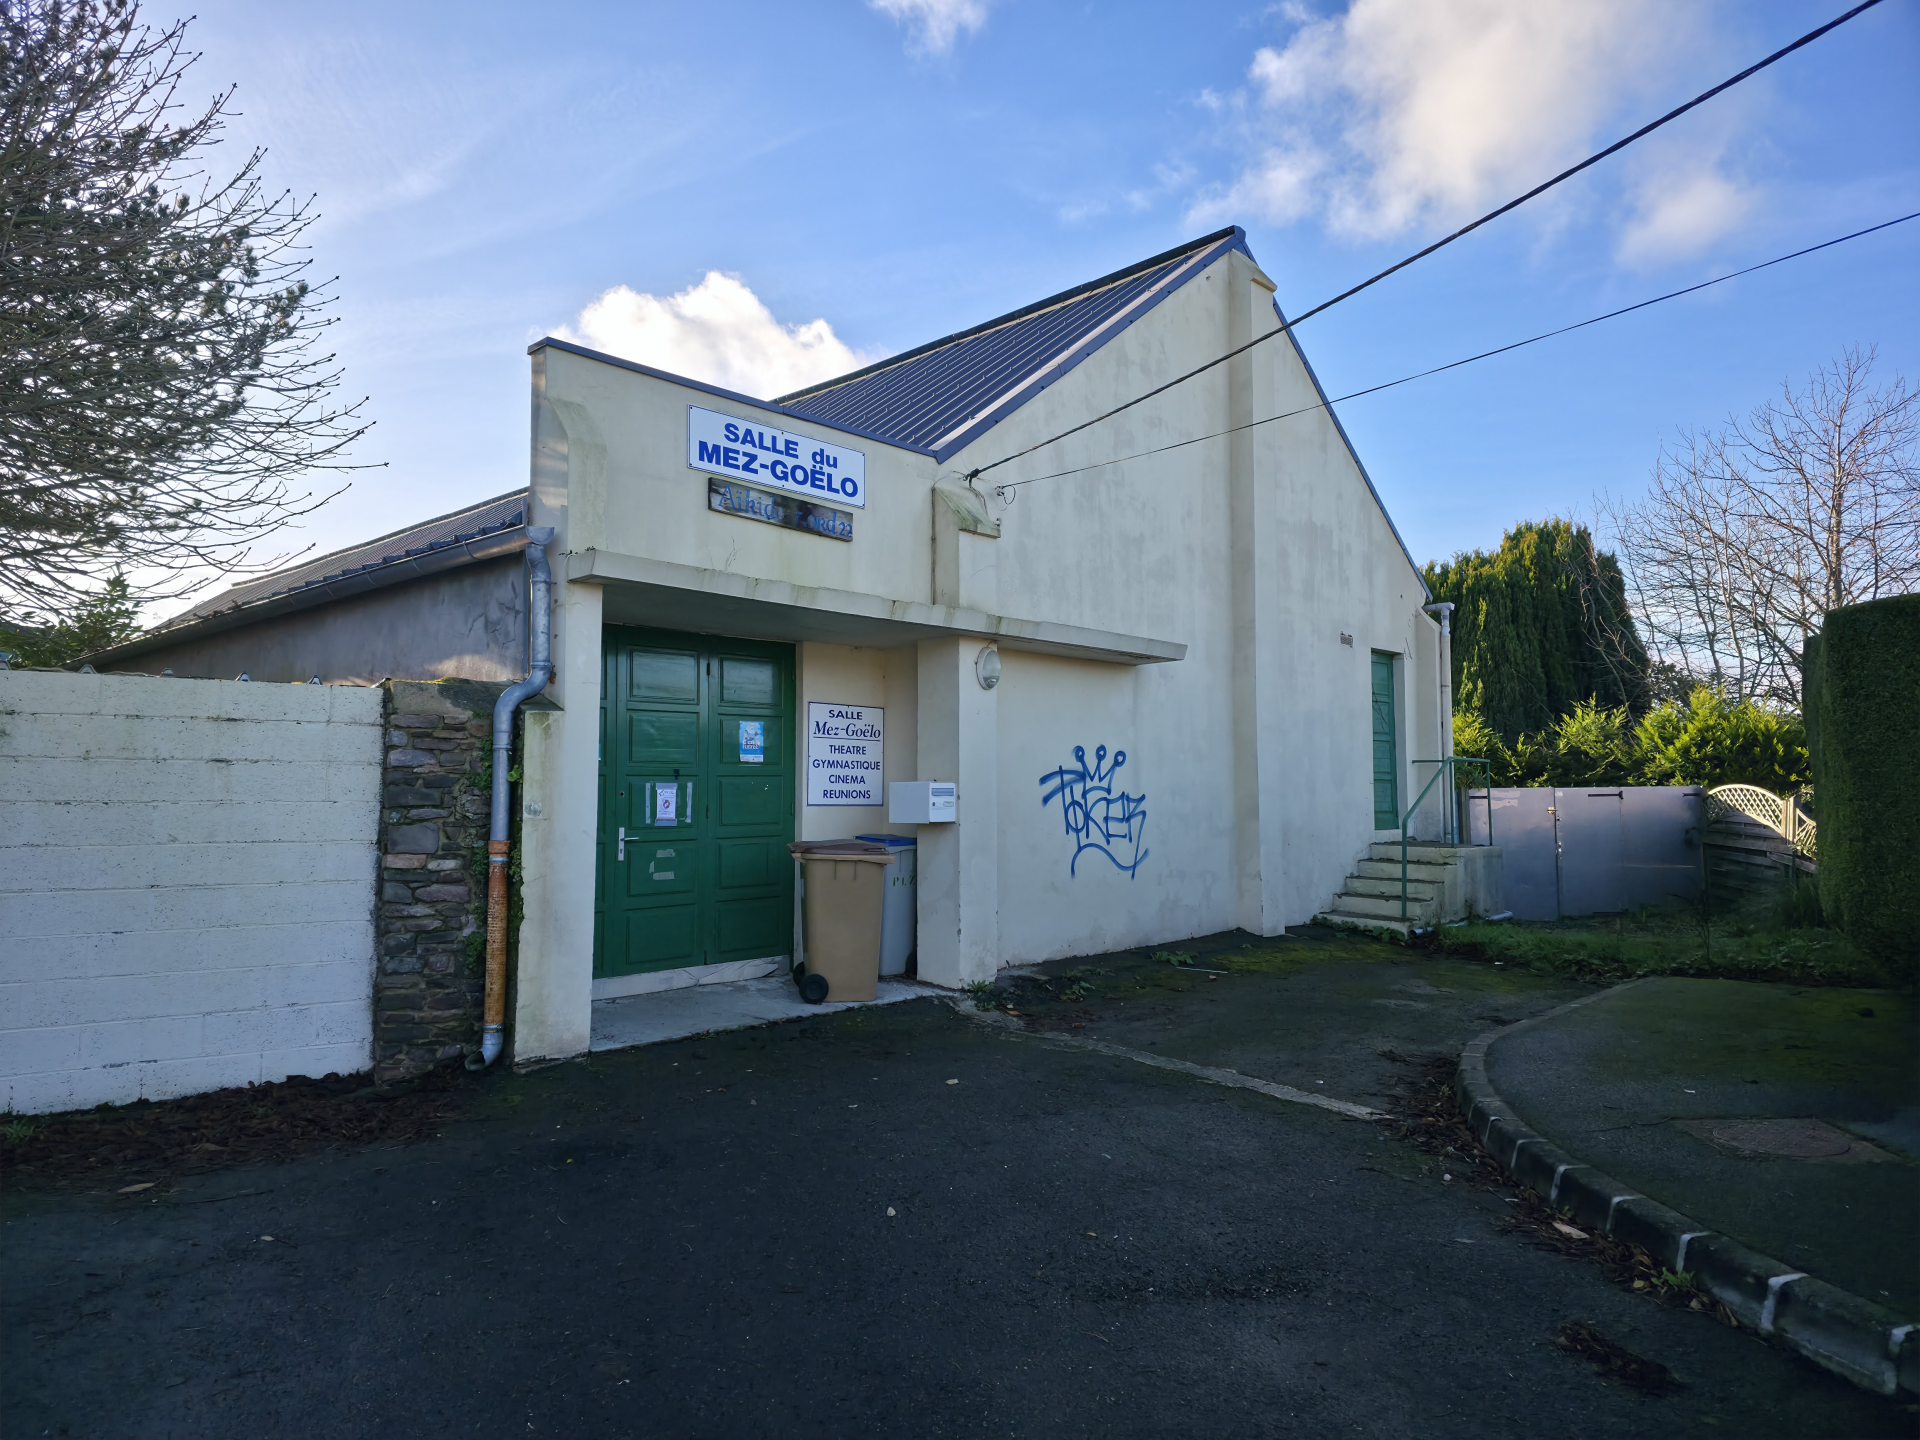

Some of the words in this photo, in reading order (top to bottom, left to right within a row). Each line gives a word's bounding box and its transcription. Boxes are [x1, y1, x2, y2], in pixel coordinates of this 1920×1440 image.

[723, 422, 799, 460] SALLE
[811, 448, 838, 470] du
[698, 440, 859, 498] MEZ-GOËLO
[718, 484, 785, 522] Aïkido
[828, 709, 863, 720] SALLE
[813, 720, 881, 739] Mez-Goëlo
[828, 744, 867, 755] THEATRE
[812, 758, 881, 771] GYMNASTIQUE
[828, 774, 866, 785] CINEMA
[822, 789, 871, 799] REUNIONS
